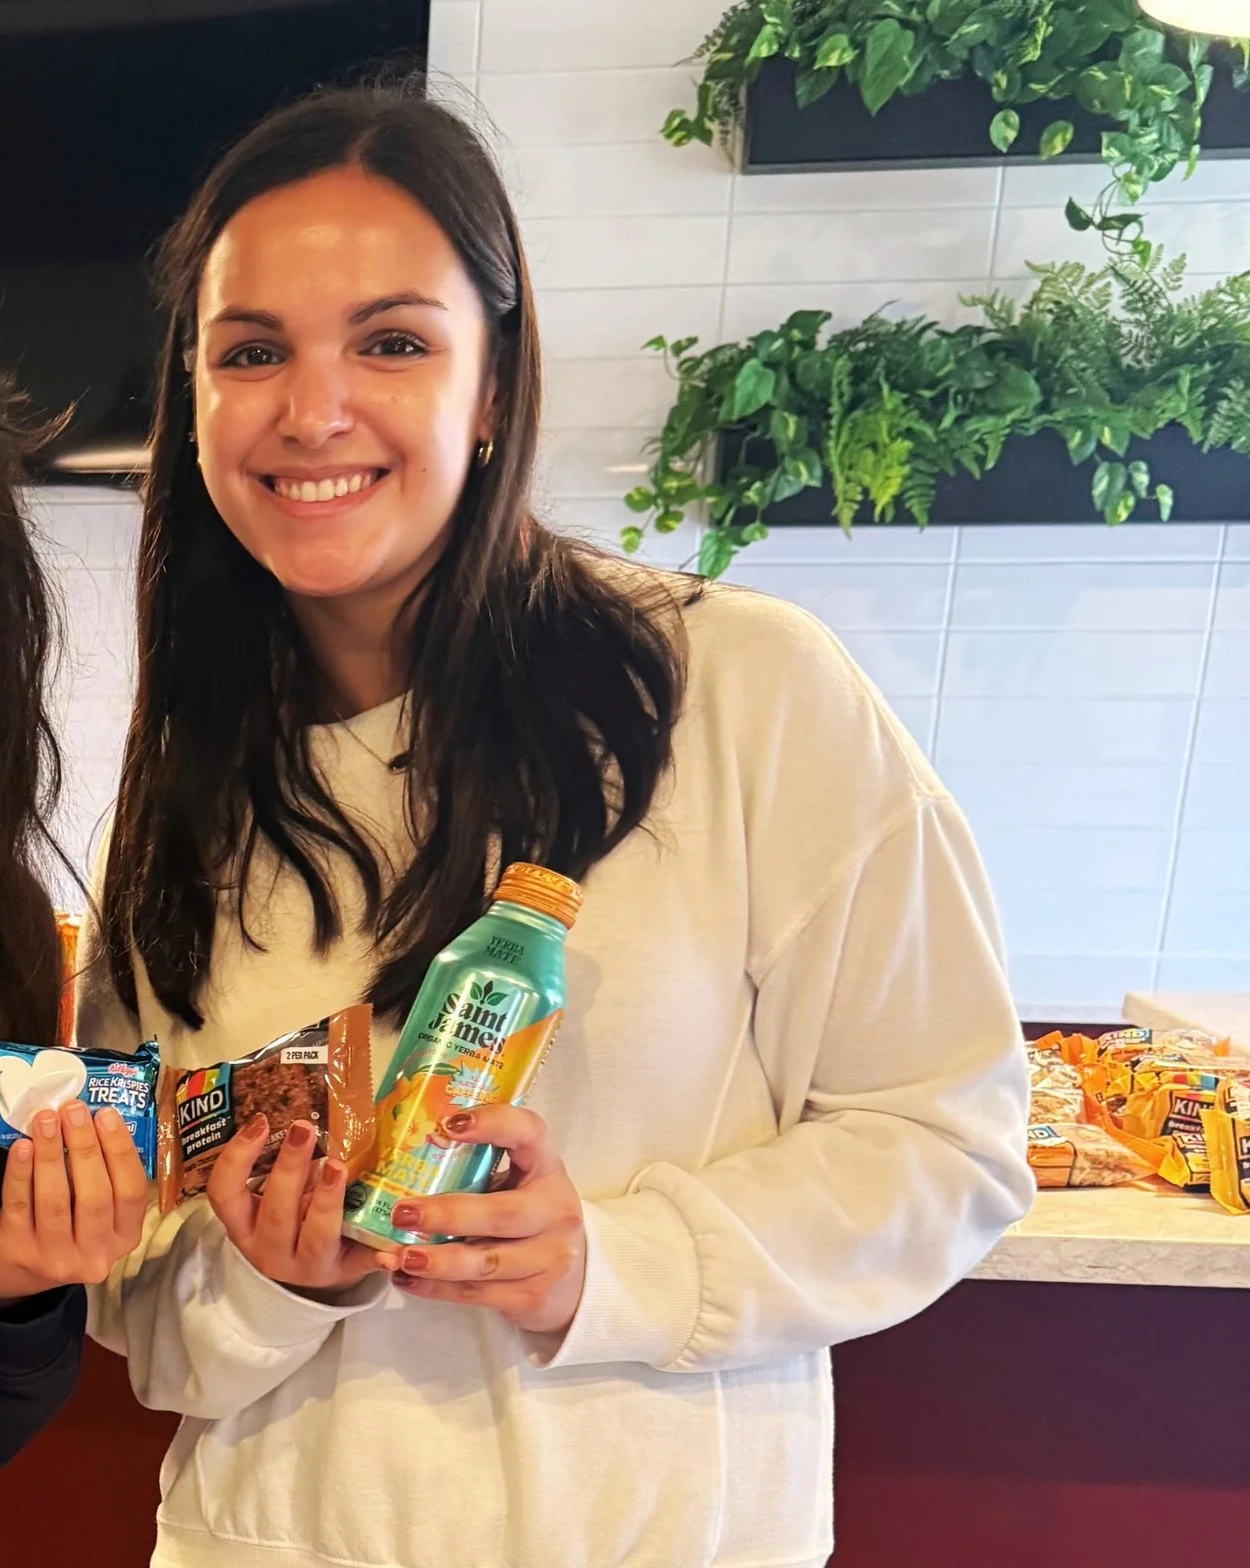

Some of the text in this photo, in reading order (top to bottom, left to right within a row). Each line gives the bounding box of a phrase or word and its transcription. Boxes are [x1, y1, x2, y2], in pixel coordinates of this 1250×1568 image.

[485, 945, 519, 965] MATE
[490, 935, 524, 956] YERBA
[441, 992, 508, 1033] Saint
[428, 1012, 506, 1055] James
[286, 1051, 319, 1060] 2 PER PACK
[454, 1044, 481, 1060] YERBA
[88, 1075, 149, 1094] RICE KRISPIES
[88, 1086, 147, 1110] TREATS
[179, 1089, 224, 1126] KIND
[1173, 1098, 1215, 1118] KIN
[186, 1131, 222, 1155] protein
